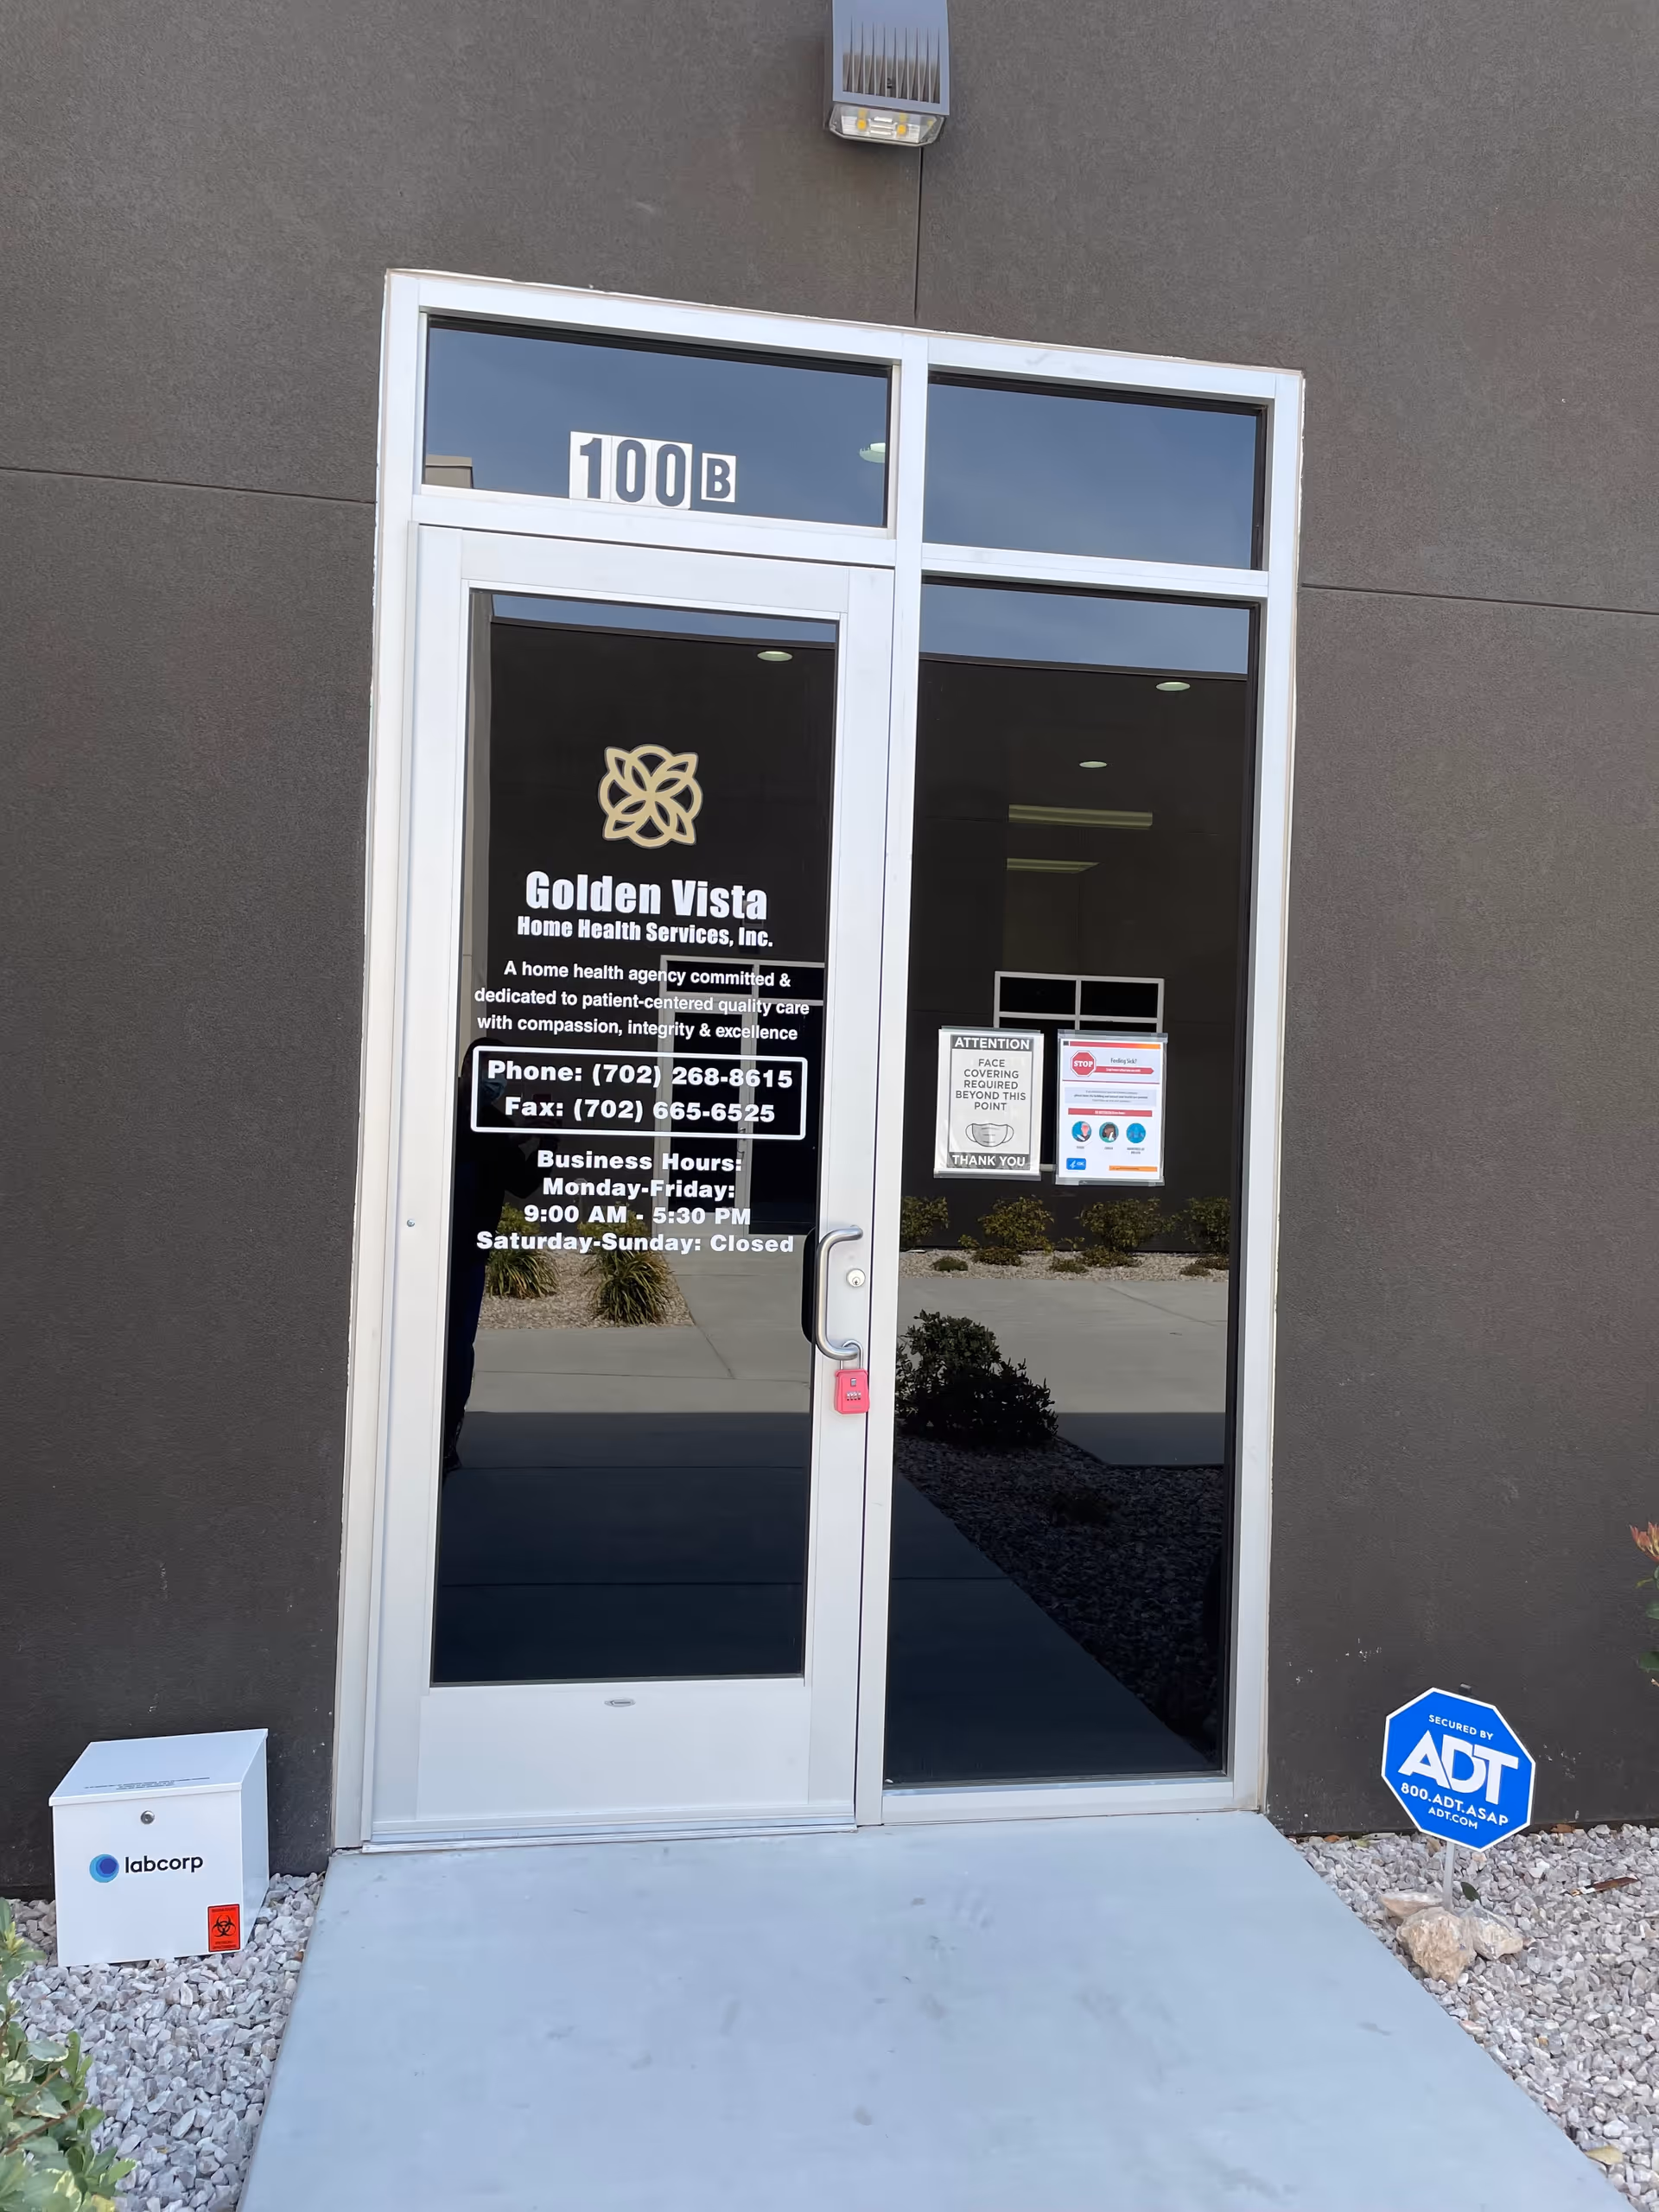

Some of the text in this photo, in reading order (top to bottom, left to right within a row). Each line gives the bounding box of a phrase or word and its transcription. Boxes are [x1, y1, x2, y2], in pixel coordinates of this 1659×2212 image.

[580, 437, 731, 507] 100 B
[525, 871, 767, 920] Golden Vista
[518, 916, 773, 948] Home Health Services, Inc.
[504, 960, 791, 987] A home health agency committed &
[474, 988, 810, 1016] dedicated to patient-centered quality care
[477, 1014, 798, 1040] with compassion, integrity & excellence
[954, 1036, 1030, 1050] ATTENTION
[488, 1059, 792, 1088] Phone: (702) 268-8615
[963, 1069, 1020, 1078] COVERING
[978, 1058, 1006, 1068] FACE
[956, 1090, 1027, 1101] BEYOND THIS
[963, 1079, 1018, 1090] REQUIRED
[505, 1096, 775, 1122] Fax: (702) 665-6525
[974, 1102, 1007, 1110] POINT
[537, 1149, 742, 1172] Business Hours:
[952, 1154, 1026, 1166] THANK YOU
[543, 1177, 734, 1202] Monday-Friday:
[524, 1205, 579, 1223] 9:00
[588, 1205, 627, 1224] AM
[653, 1207, 705, 1224] 5:30
[715, 1207, 751, 1225] PM
[476, 1230, 793, 1255] Saturday-Sunday: Closed
[1428, 1714, 1493, 1740] SECURED BY
[1397, 1729, 1519, 1805] ADT
[1401, 1783, 1509, 1827] 800.ADT.ASAP
[1428, 1807, 1478, 1829] ADT.COM
[125, 1855, 204, 1874] labcorp
